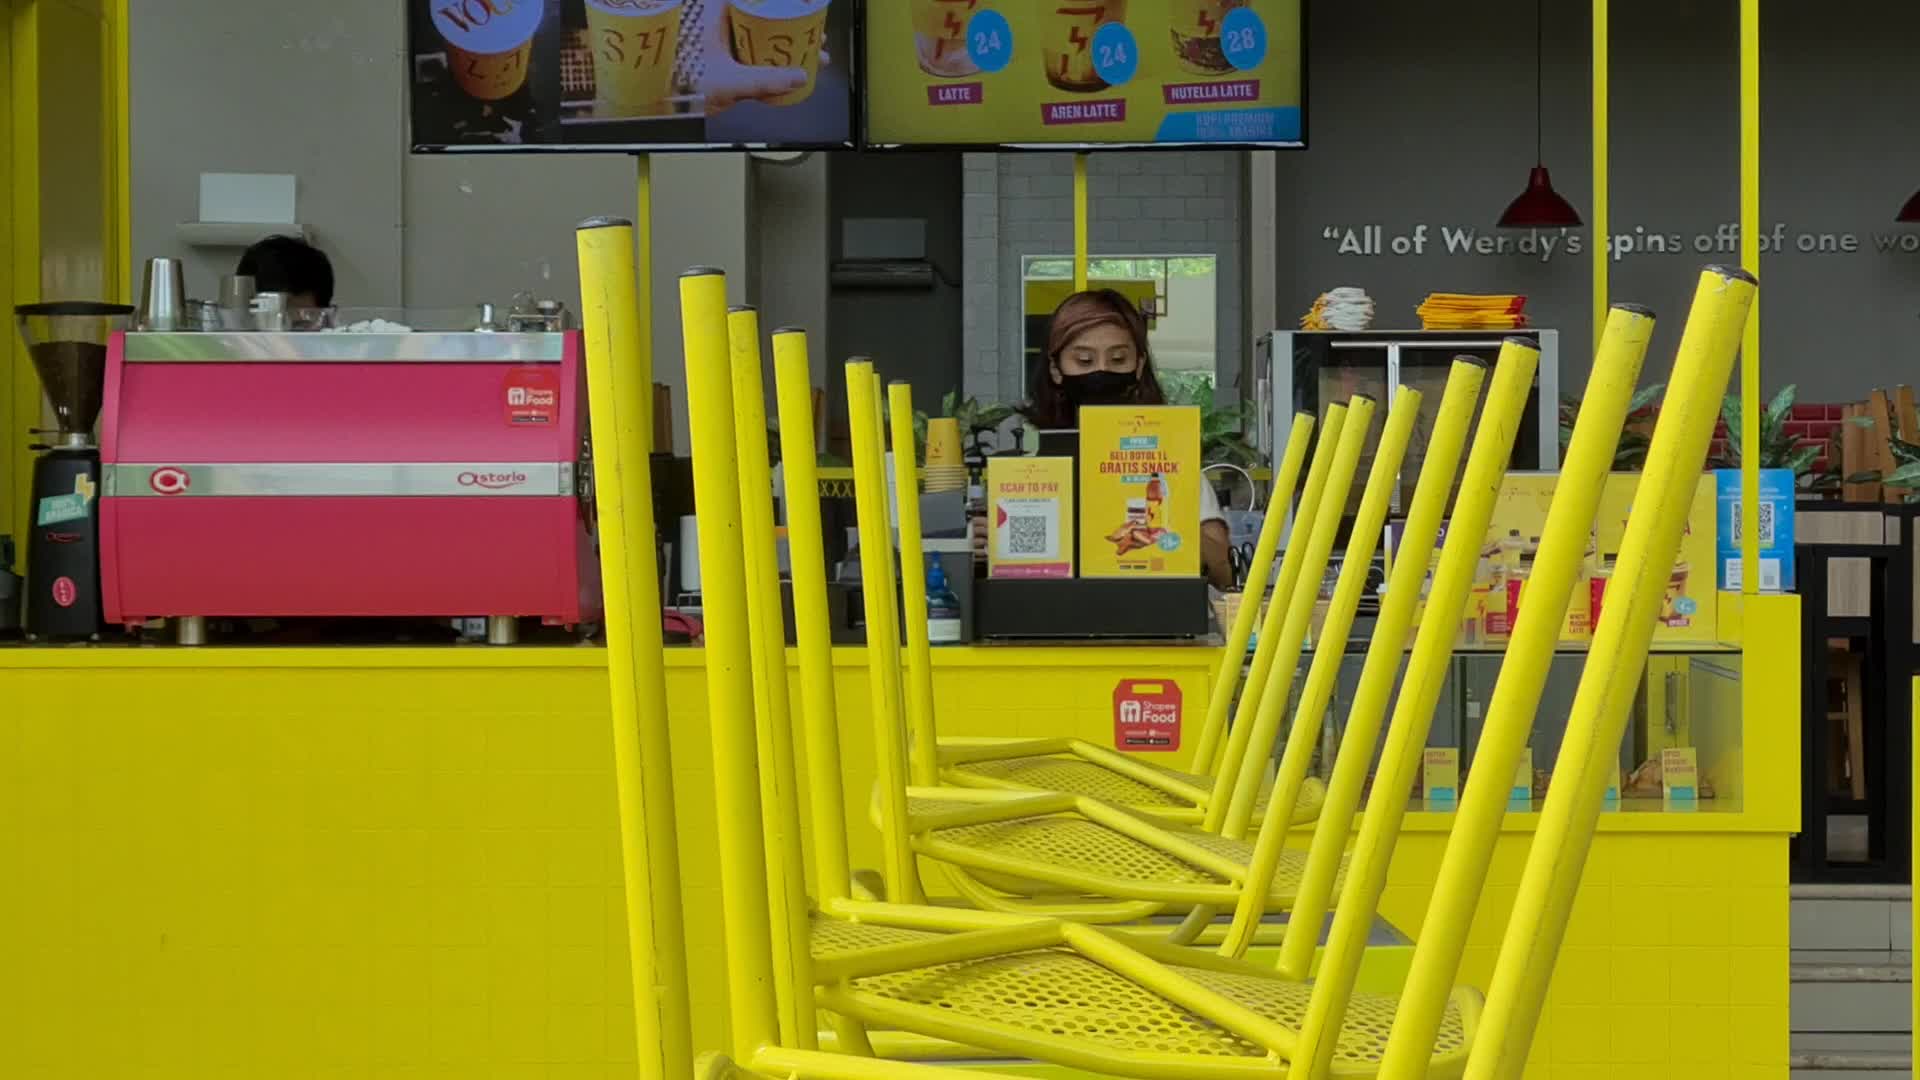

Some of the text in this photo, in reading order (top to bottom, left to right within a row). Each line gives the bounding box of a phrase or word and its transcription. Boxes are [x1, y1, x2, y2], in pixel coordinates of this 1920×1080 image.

[974, 31, 1002, 55] 24
[1227, 27, 1255, 53] 28
[1100, 42, 1127, 68] 24
[938, 87, 971, 101] LATTE
[1171, 84, 1253, 99] NUTELLA LATTE
[1051, 103, 1118, 120] AREN LATTE
[1391, 225, 1427, 254] of
[1441, 227, 1582, 261] Wendy's
[1694, 223, 1740, 252] off
[1797, 233, 1858, 252] one
[526, 394, 553, 405] Food
[1099, 462, 1179, 474] GRATIS SNACK
[999, 482, 1059, 493] SCAN TO PAY
[1142, 711, 1176, 723] Food
